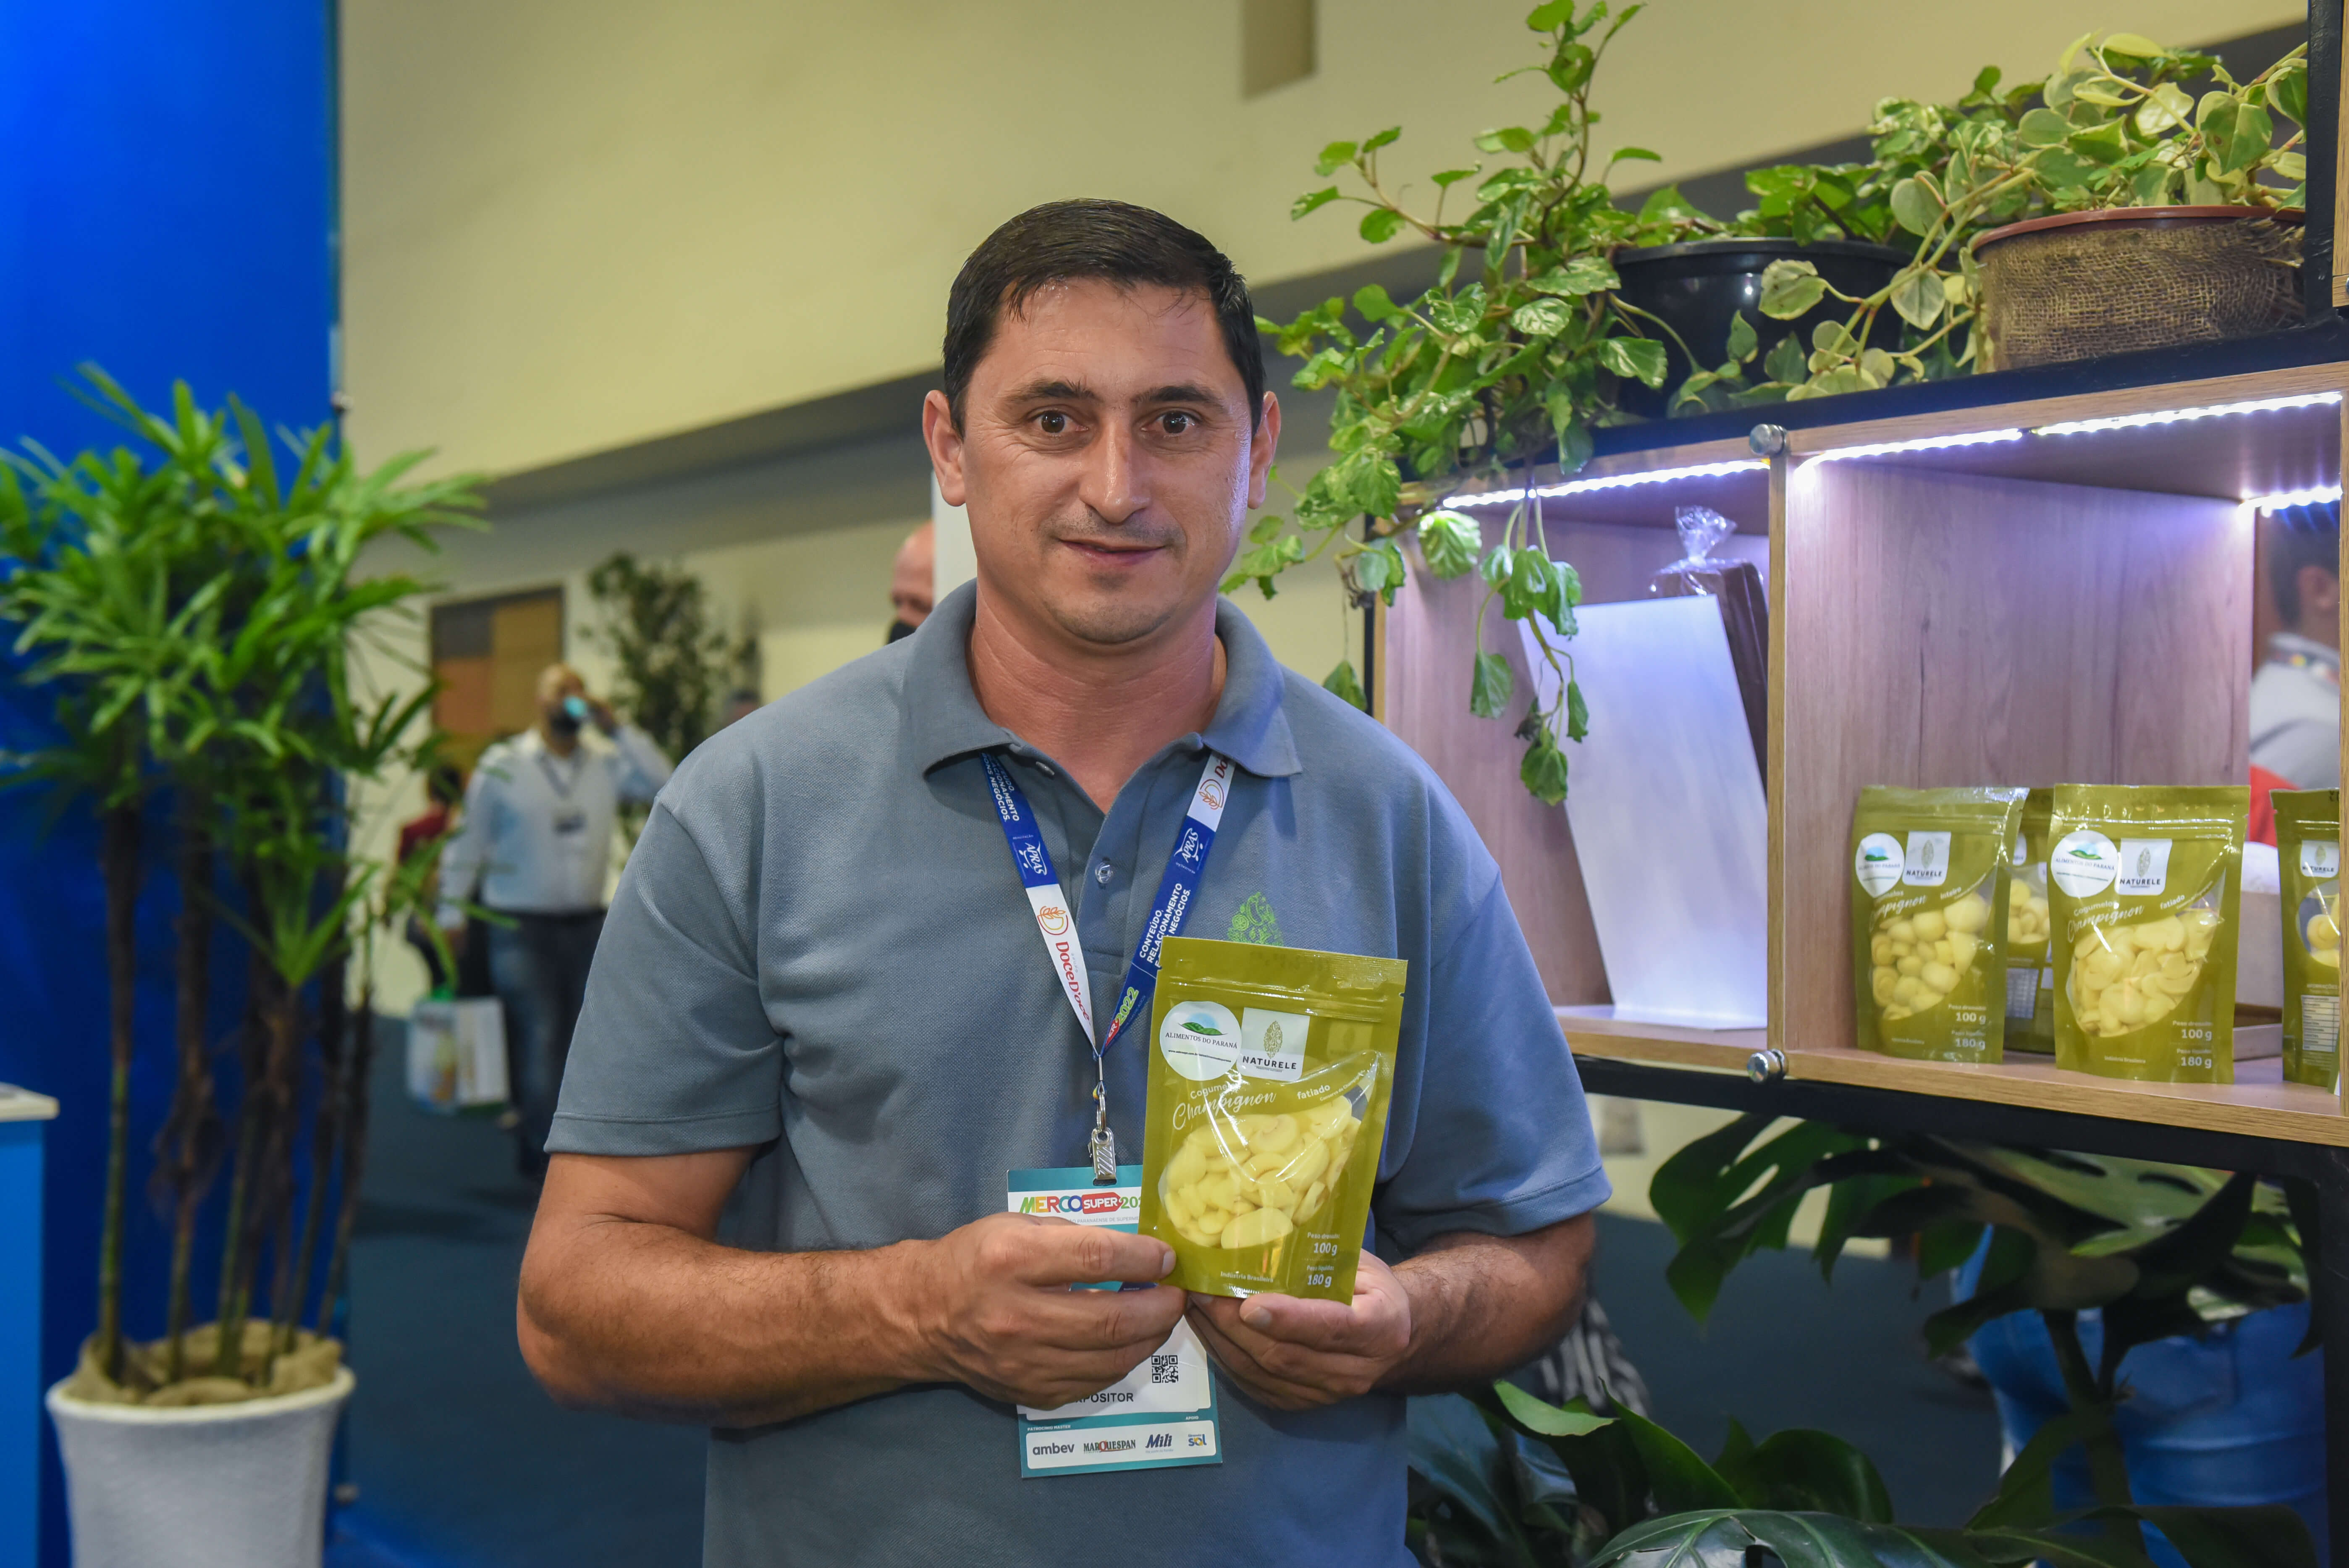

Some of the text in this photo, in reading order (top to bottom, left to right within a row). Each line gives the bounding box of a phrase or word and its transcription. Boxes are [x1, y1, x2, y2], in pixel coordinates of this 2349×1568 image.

[1182, 829, 1198, 863] APRAS
[1024, 841, 1047, 876] APRAS
[2074, 900, 2119, 917] Cogumelo
[1147, 883, 1182, 963] RELACIONAMENTO
[1115, 987, 1139, 1026] 2022
[1956, 1012, 1986, 1025] 100 g
[1165, 1032, 1201, 1041] ALIMENTOS
[1212, 1039, 1237, 1049] PARANÁ
[2181, 1029, 2212, 1041] 100 g
[1955, 1038, 1986, 1051] 180 g
[1243, 1056, 1297, 1070] NATURELE
[2181, 1056, 2212, 1069] 180 g
[1297, 1085, 1331, 1100] fatiado
[1173, 1092, 1277, 1130] Champignon
[1313, 1243, 1337, 1256] 100 g
[1307, 1274, 1332, 1288] 180 g
[1083, 1440, 1136, 1453] MARQUESPAN
[1145, 1433, 1172, 1448] Mili
[1188, 1434, 1207, 1447] sol
[1033, 1442, 1075, 1455] ambev
